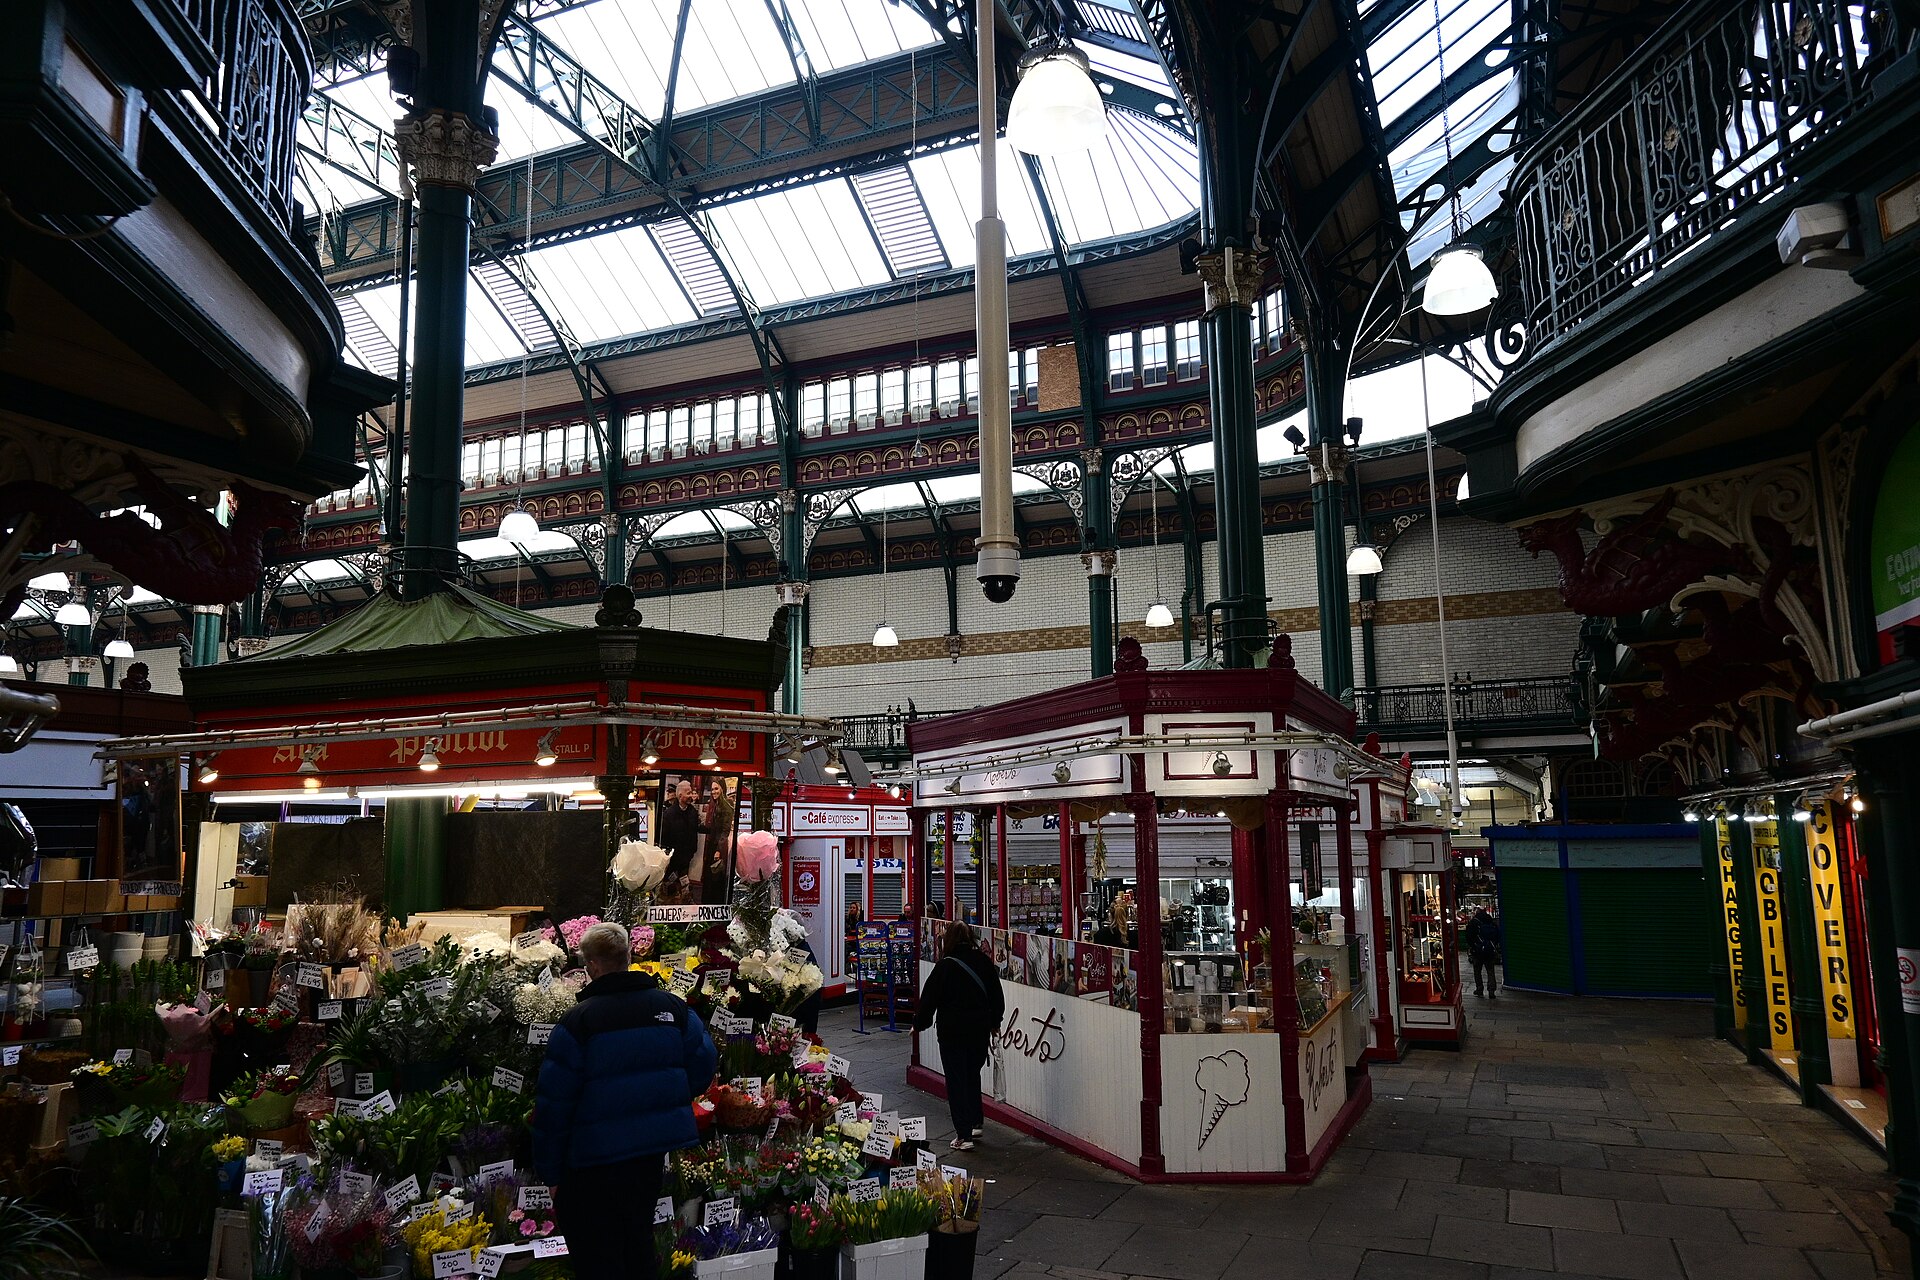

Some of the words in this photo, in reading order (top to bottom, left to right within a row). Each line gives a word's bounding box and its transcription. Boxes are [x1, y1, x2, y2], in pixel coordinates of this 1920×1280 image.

[555, 744, 580, 754] STALL
[584, 743, 590, 753] P
[807, 811, 827, 824] Café
[828, 814, 855, 827] express
[1043, 815, 1060, 829] BR
[649, 908, 682, 921] FLOWERS
[1811, 805, 1850, 1023] COVERS
[1720, 845, 1747, 1008] CHARGERS
